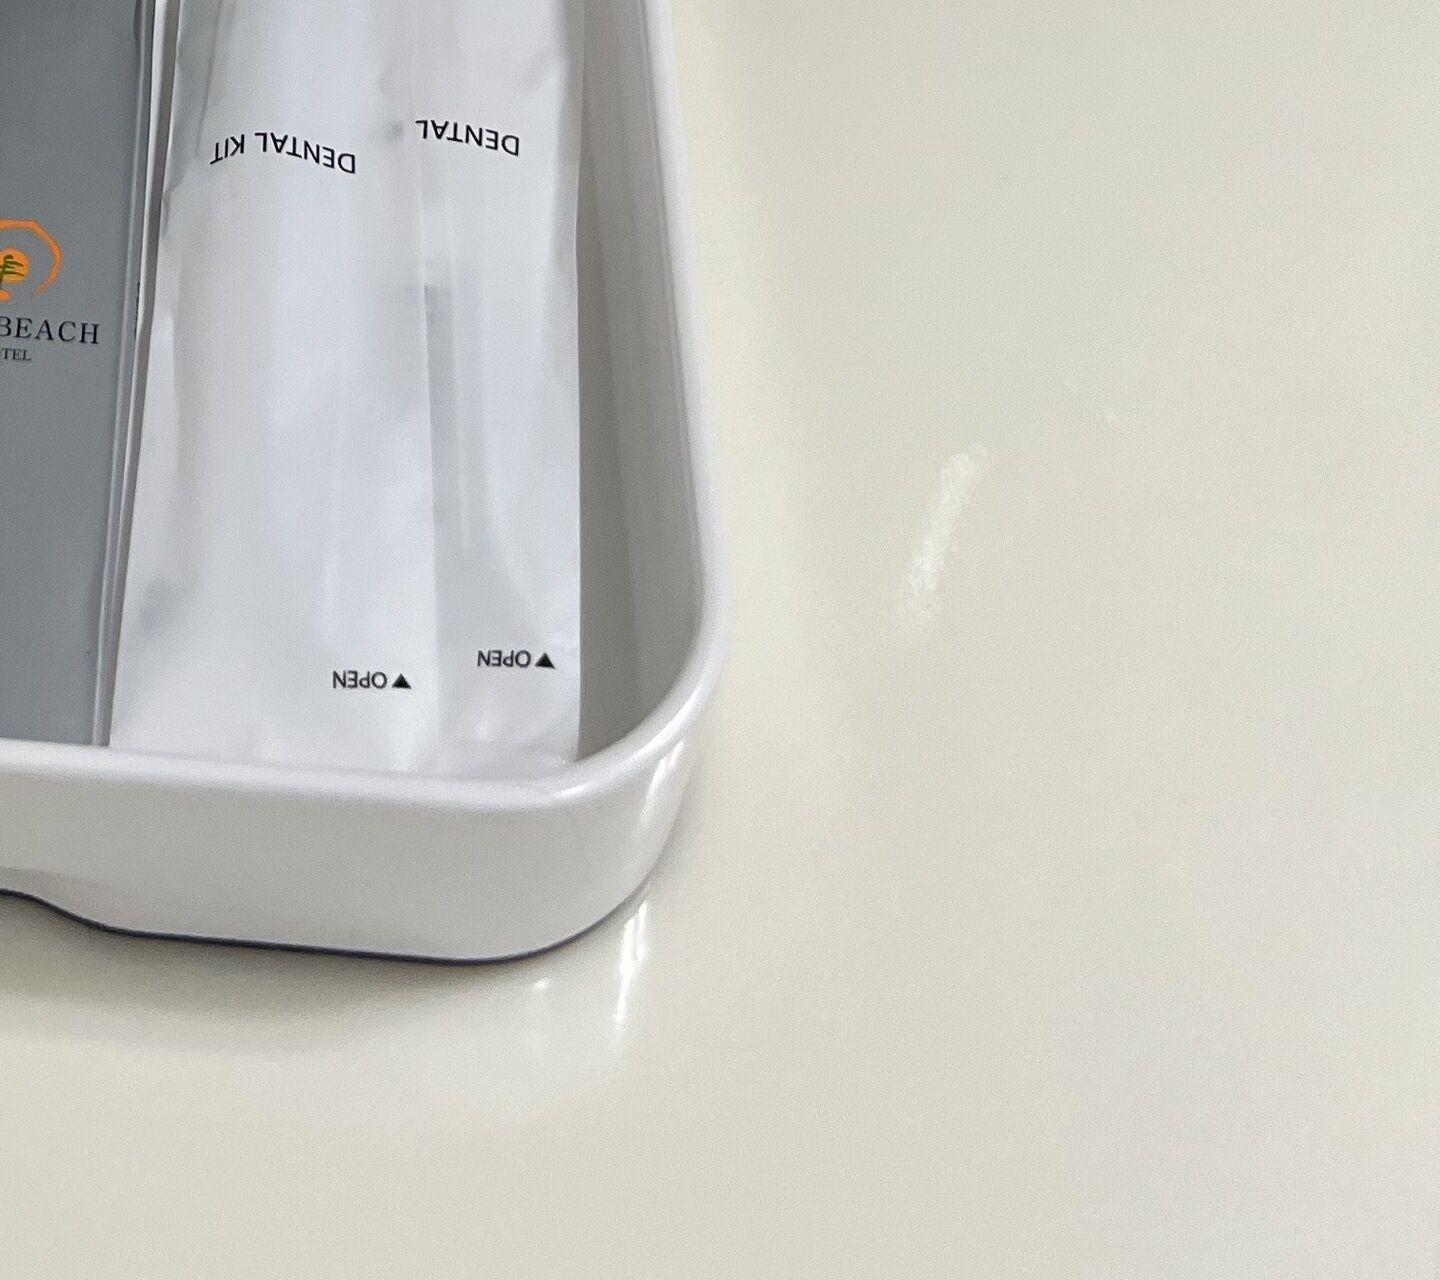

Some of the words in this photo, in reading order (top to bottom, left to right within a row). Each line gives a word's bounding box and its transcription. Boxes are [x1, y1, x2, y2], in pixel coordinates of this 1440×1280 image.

[210, 134, 245, 165] KIT
[255, 132, 356, 174] DENTAL
[415, 119, 519, 157] DENTAL
[476, 650, 532, 669] OPEN
[332, 670, 388, 689] OPEN
